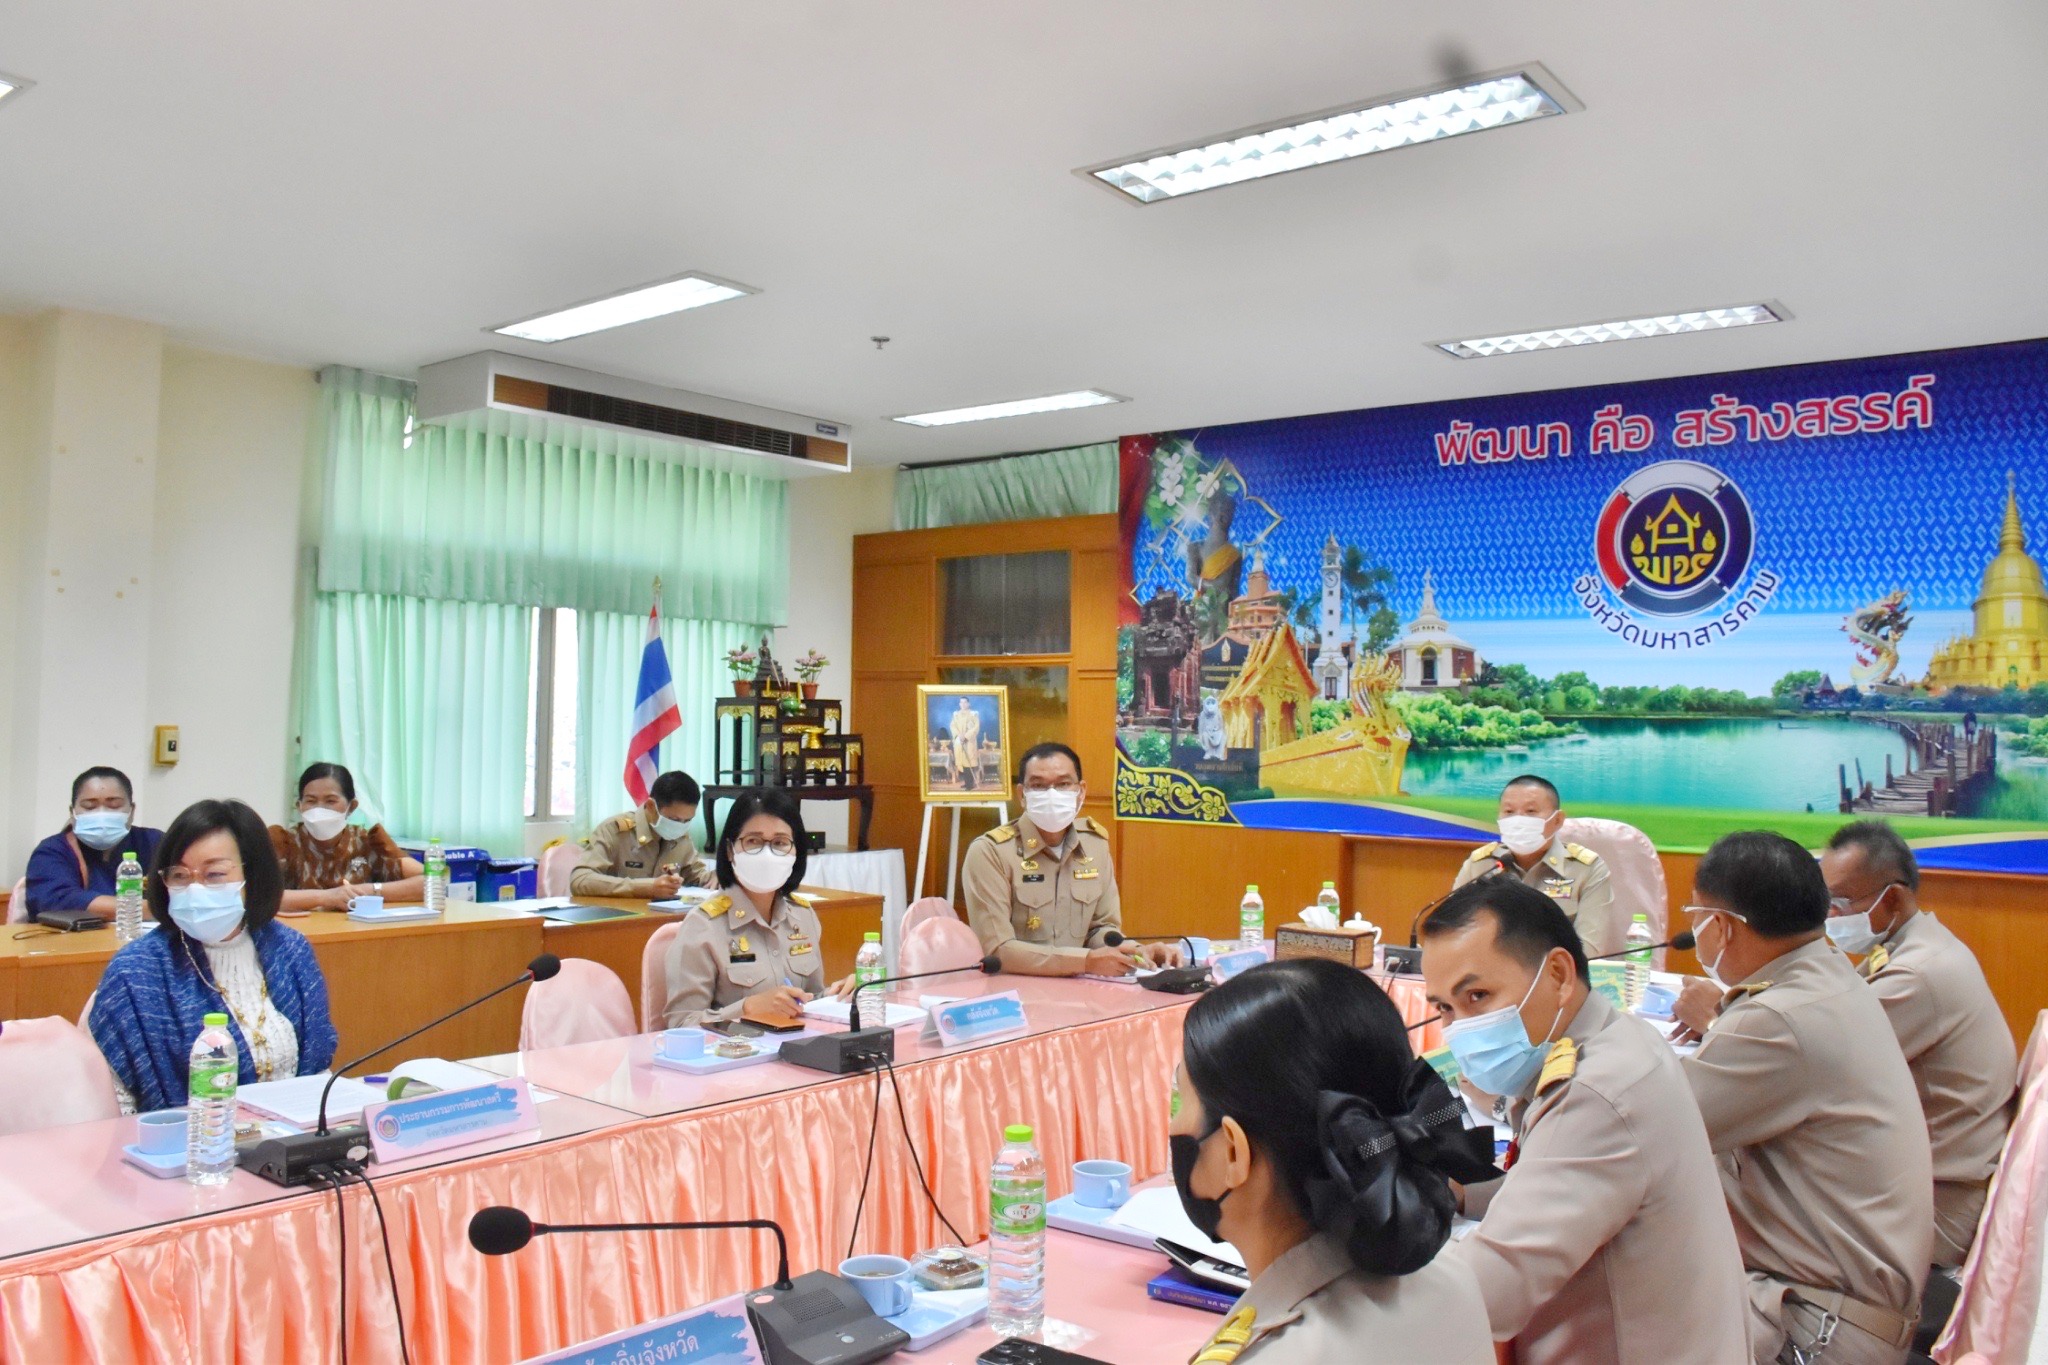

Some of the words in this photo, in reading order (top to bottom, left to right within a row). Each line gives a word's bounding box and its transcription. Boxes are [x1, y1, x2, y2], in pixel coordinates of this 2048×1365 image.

[1436, 421, 1570, 465] พัฒนา
[1591, 405, 1653, 454] คือ
[1674, 375, 1934, 446] สร้างสรรค์
[1574, 572, 1777, 650] จังหวัดมหาสารคาม
